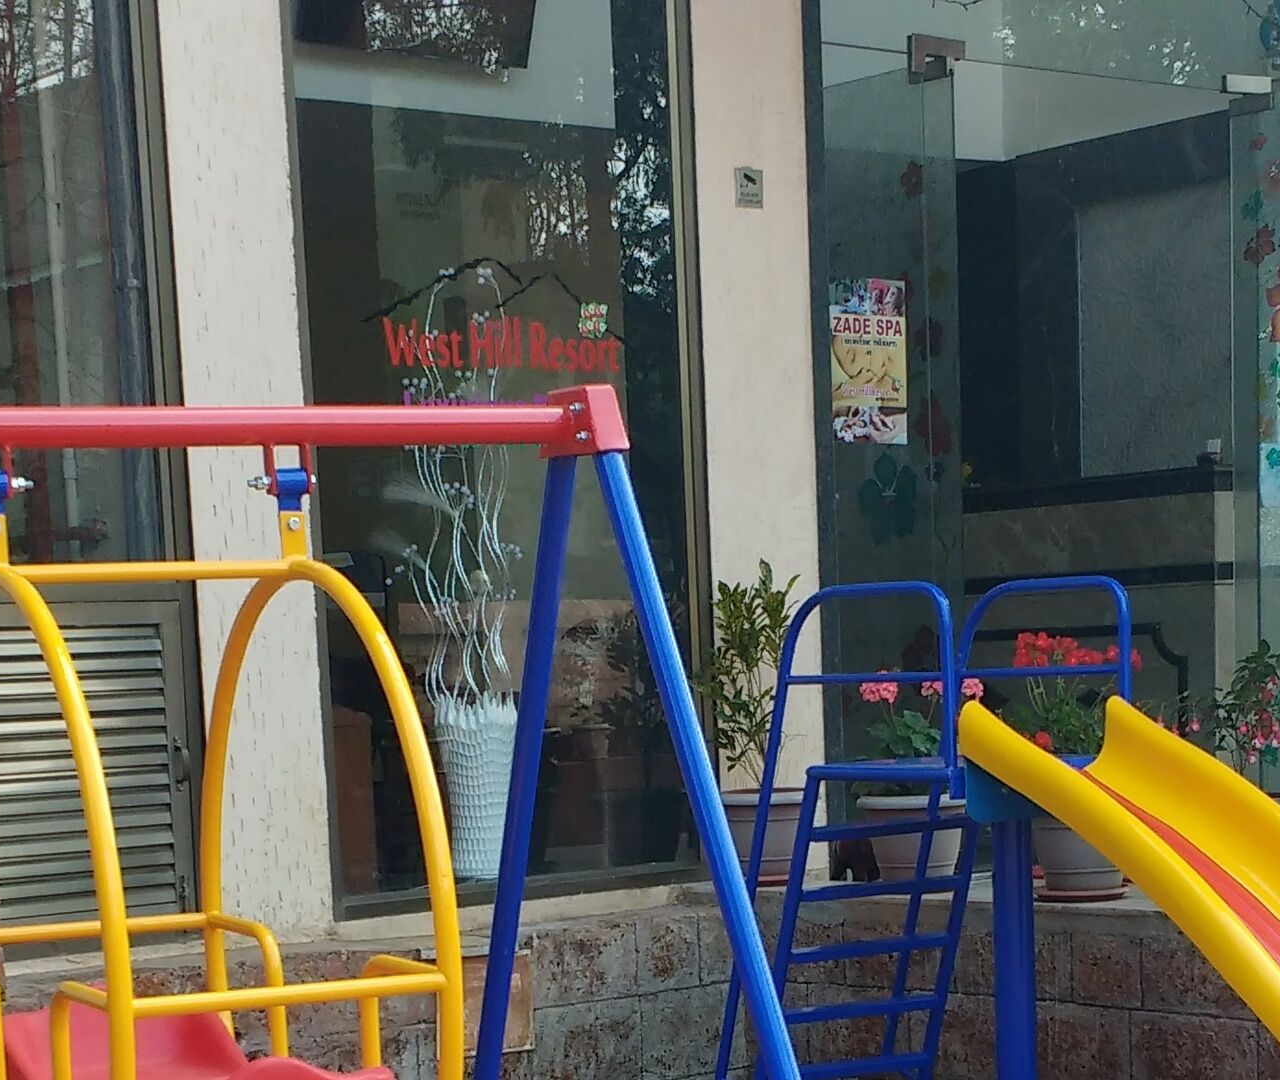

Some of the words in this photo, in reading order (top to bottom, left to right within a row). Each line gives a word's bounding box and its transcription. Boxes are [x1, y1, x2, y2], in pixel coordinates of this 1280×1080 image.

[383, 316, 464, 368] West
[470, 315, 521, 369] Hill
[529, 322, 619, 373] Resort
[833, 316, 871, 335] ZADE
[876, 319, 903, 337] SPA
